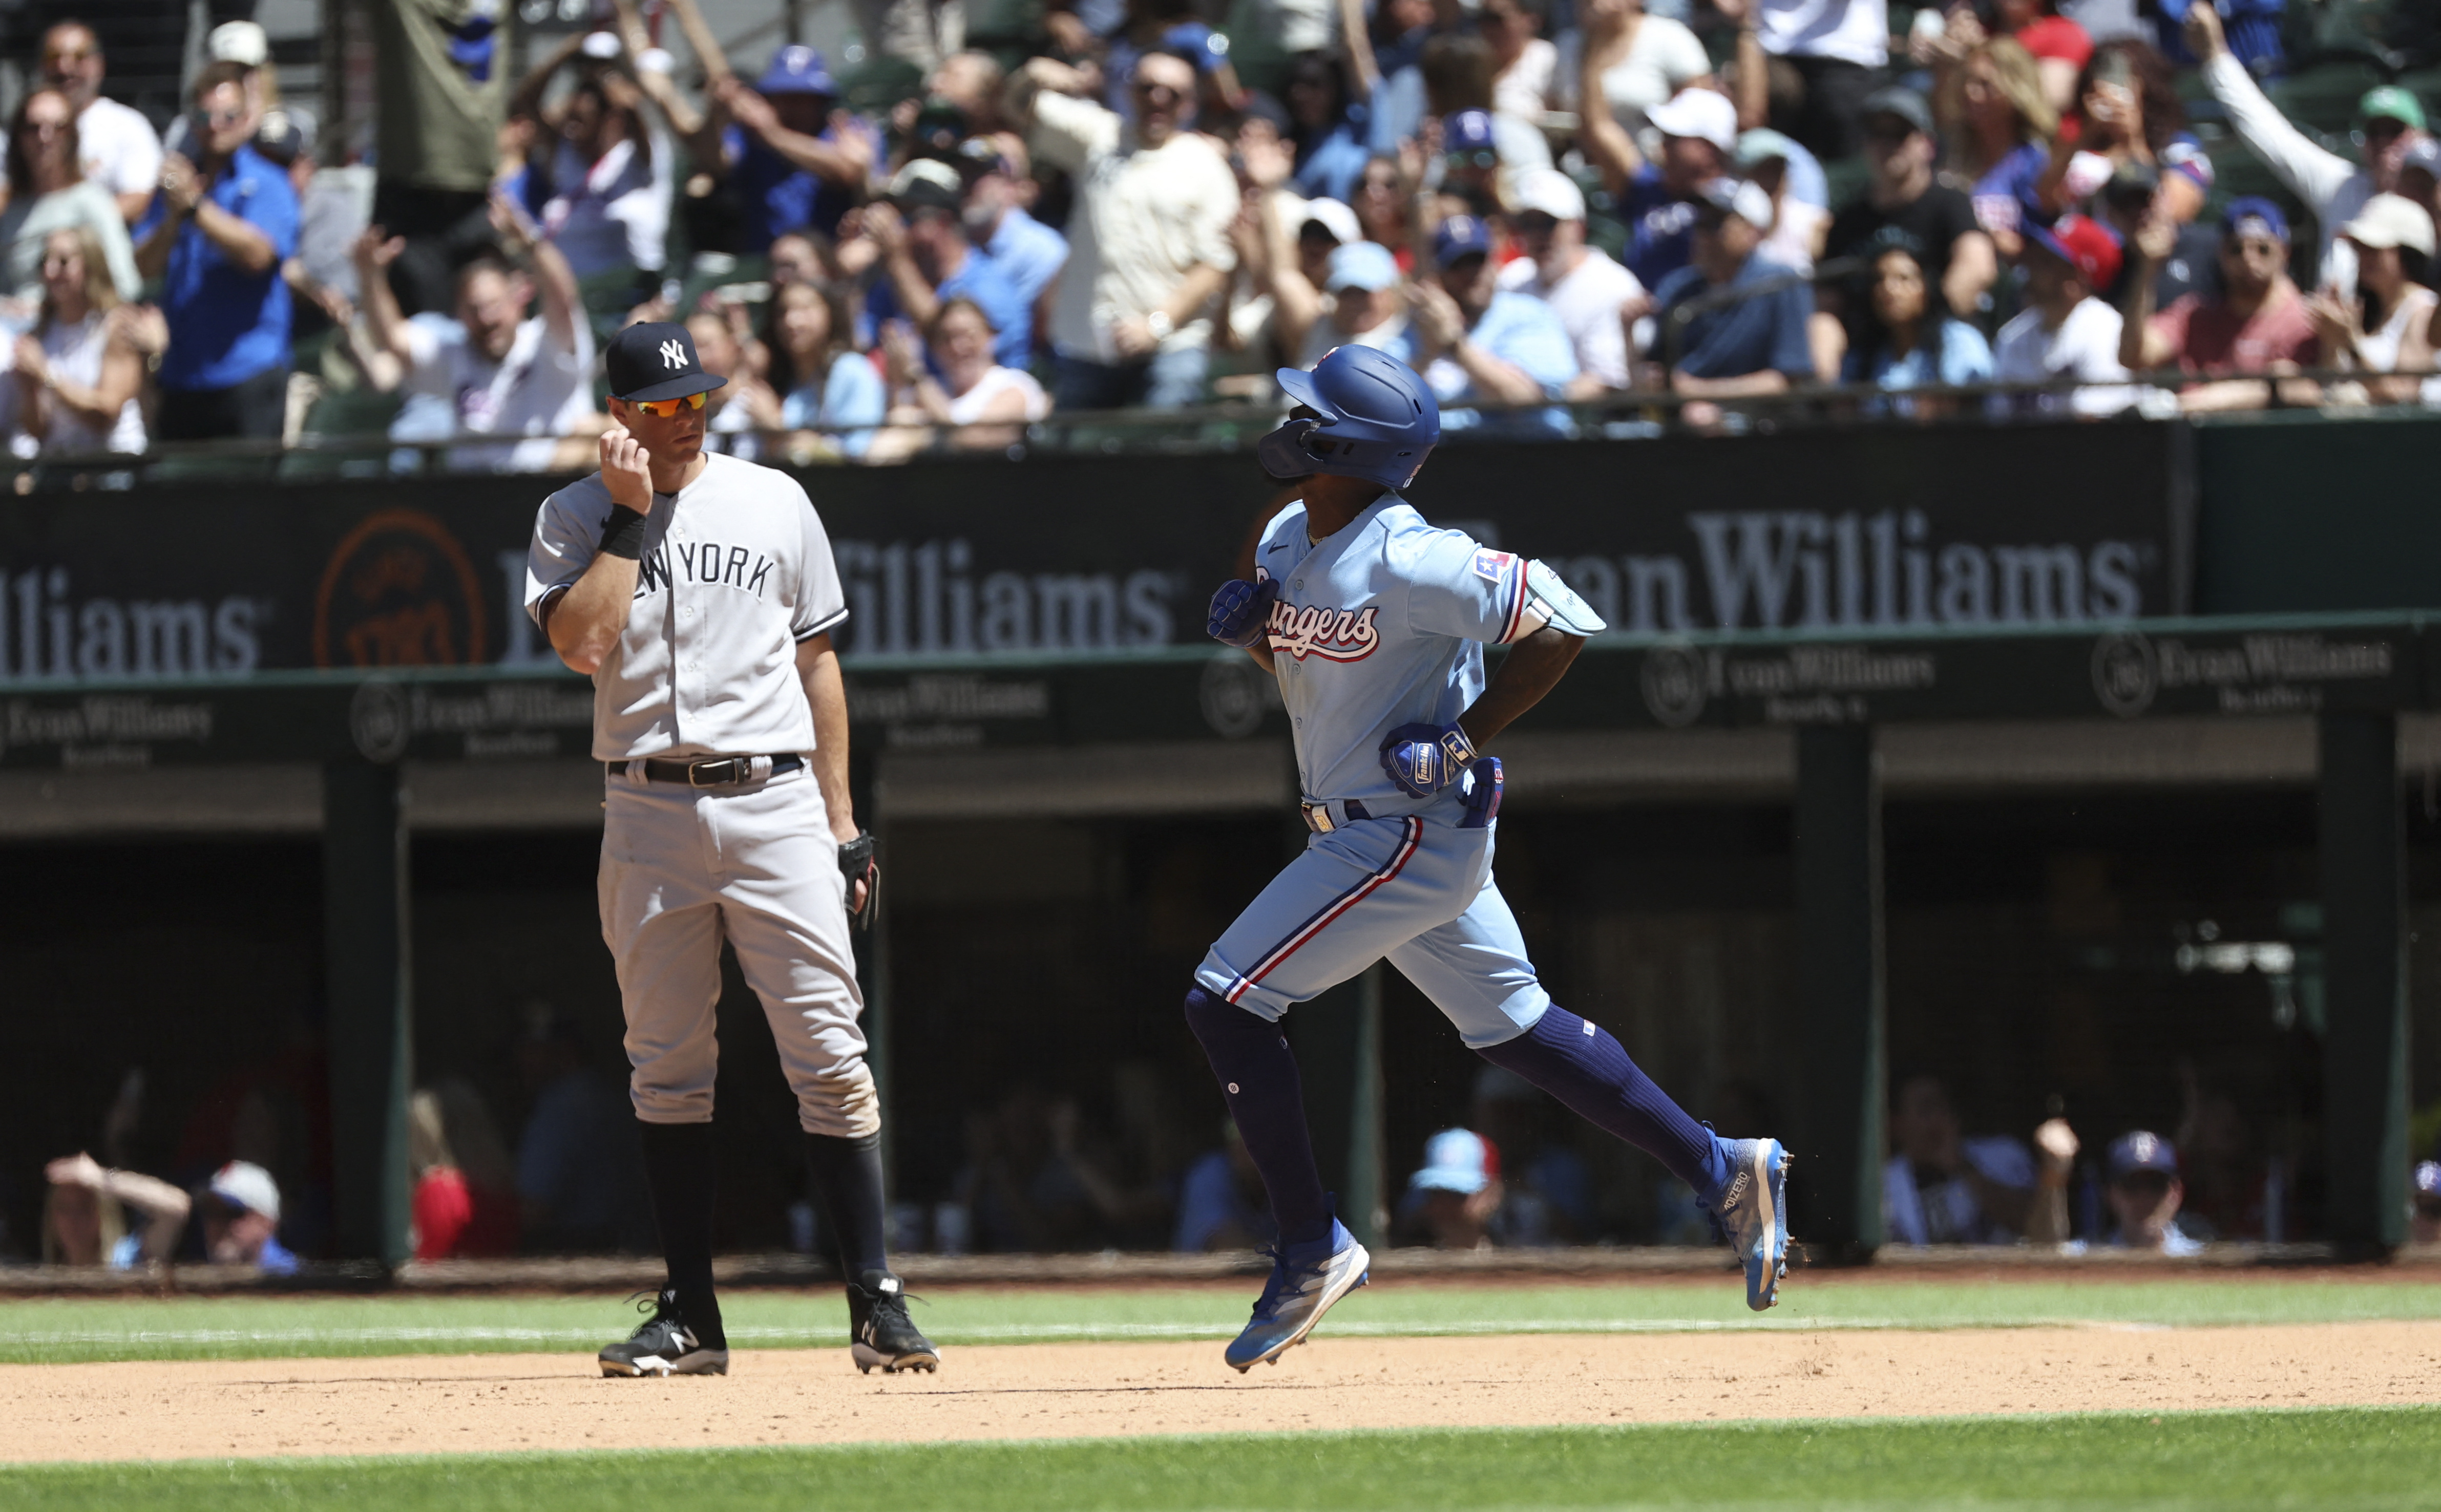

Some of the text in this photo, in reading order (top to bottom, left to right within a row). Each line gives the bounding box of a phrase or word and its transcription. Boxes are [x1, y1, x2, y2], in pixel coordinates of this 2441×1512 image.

[659, 338, 689, 370] NY
[675, 540, 776, 602] YORK
[835, 537, 1178, 659] illiams
[1684, 506, 2144, 631] Williams
[1724, 1172, 1748, 1210] ADIZERO
